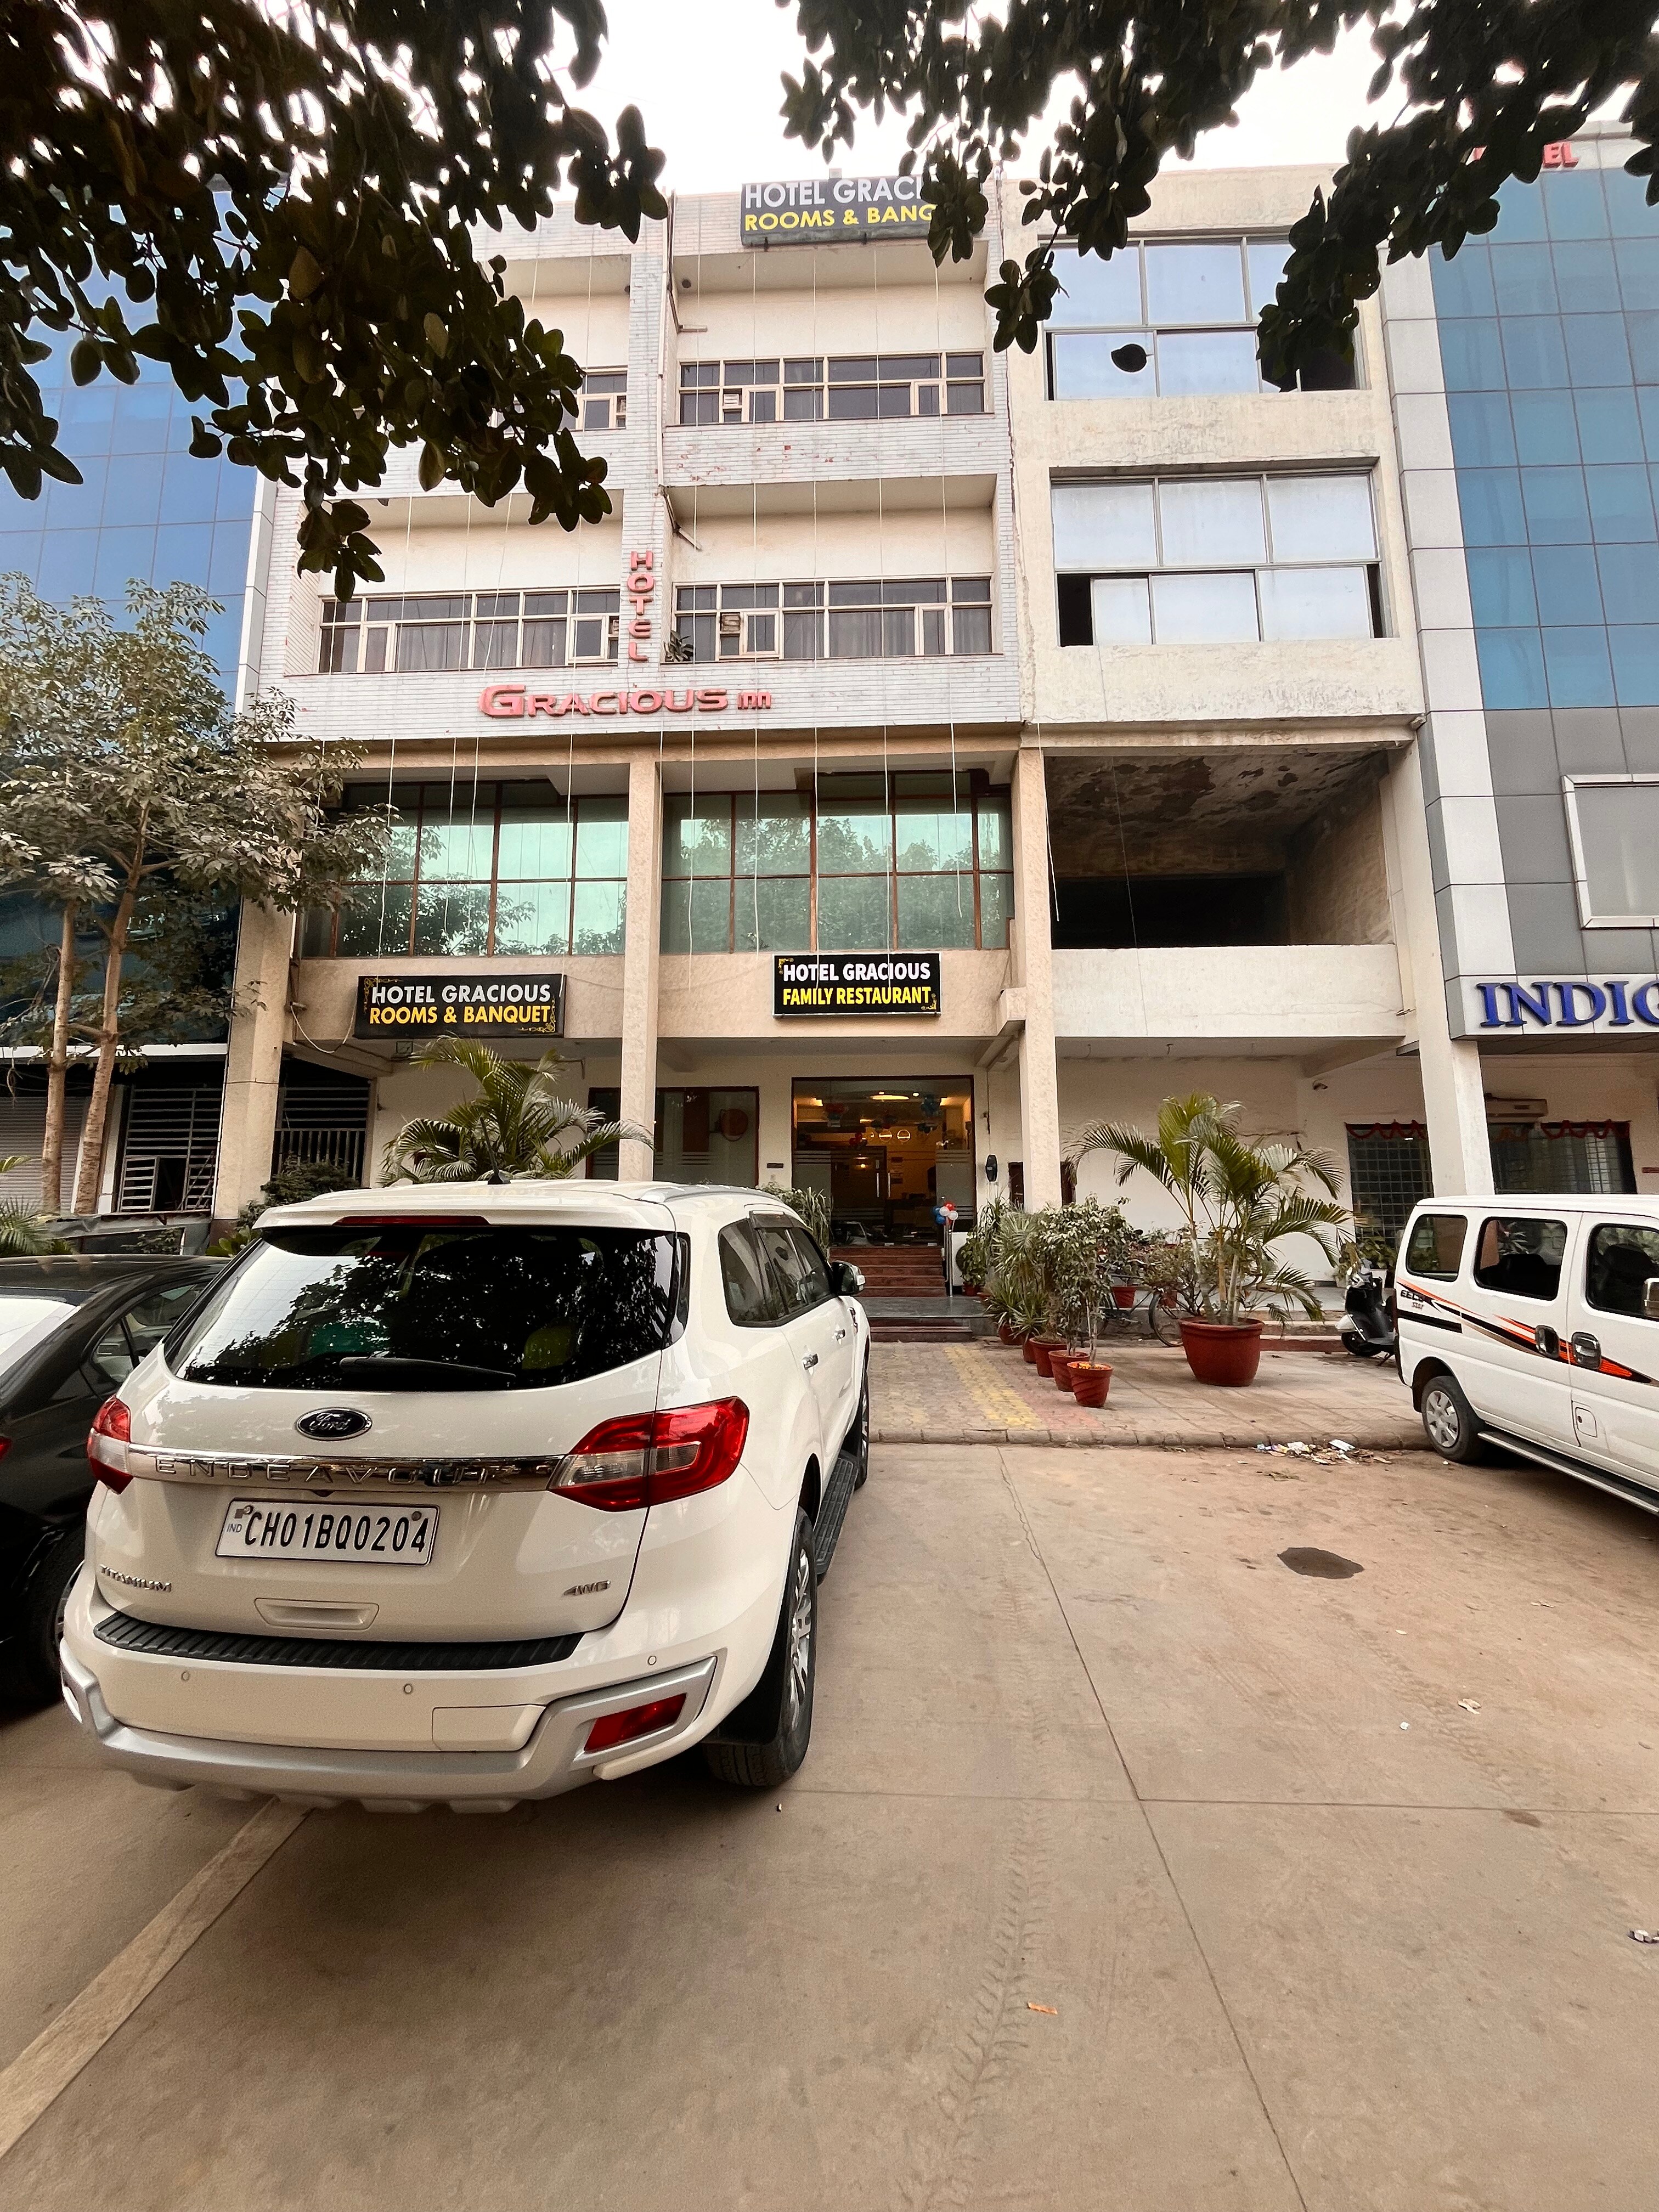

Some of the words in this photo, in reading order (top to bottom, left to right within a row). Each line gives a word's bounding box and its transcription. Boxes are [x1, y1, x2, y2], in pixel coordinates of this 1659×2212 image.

[744, 180, 825, 209] HOTEL
[833, 174, 923, 204] GRACI
[744, 209, 835, 231] ROOMS
[843, 208, 860, 226] &
[627, 550, 655, 662] HOTEL
[783, 964, 839, 982] HOTEL
[843, 962, 931, 980] GRACIOUS
[371, 985, 436, 1005] HOTEL
[442, 984, 551, 1002] GRACIOUS
[783, 988, 834, 1006] FAMILY
[836, 986, 932, 1005] RESTAURANT
[369, 1006, 438, 1024] ROOMS
[443, 1007, 458, 1024] &
[464, 1005, 551, 1024] BANQUET
[309, 1412, 352, 1432] Ford
[226, 1523, 242, 1533] IND
[244, 1511, 430, 1553] CH01BQ0204
[100, 1564, 172, 1593] TITANIUM
[563, 1580, 611, 1596] 4WD
